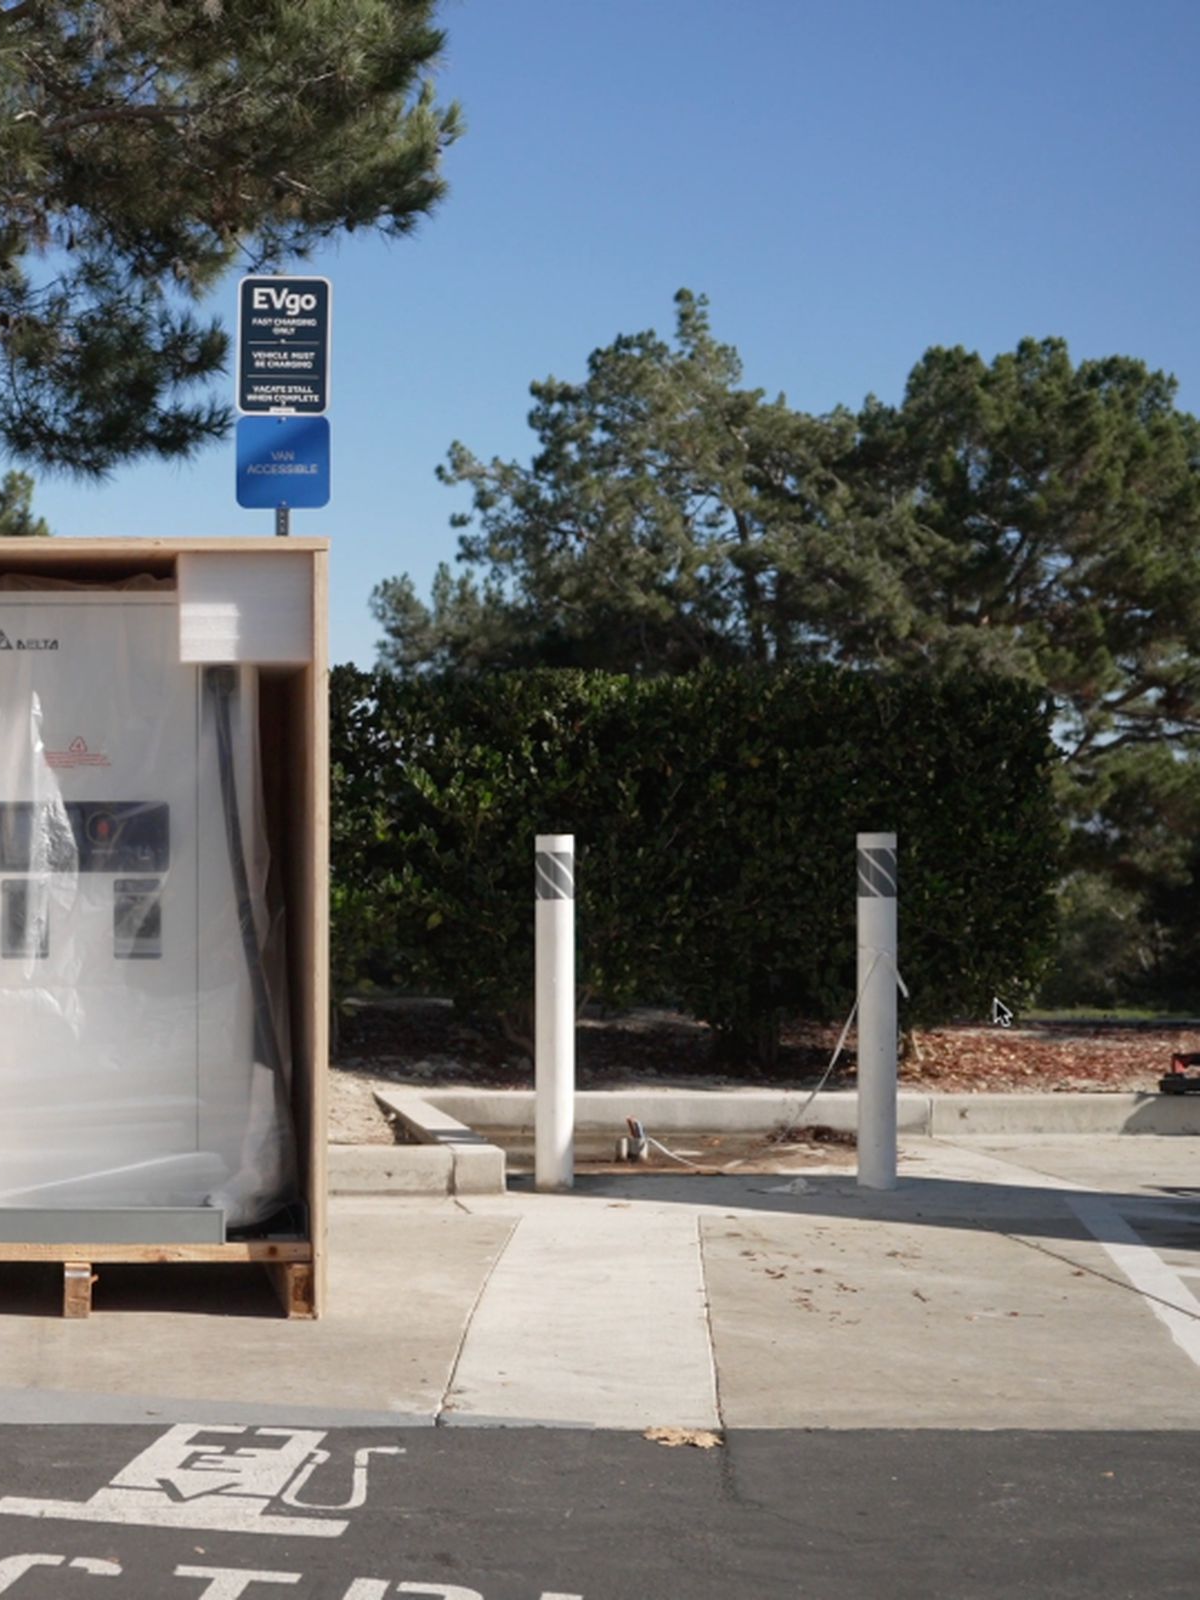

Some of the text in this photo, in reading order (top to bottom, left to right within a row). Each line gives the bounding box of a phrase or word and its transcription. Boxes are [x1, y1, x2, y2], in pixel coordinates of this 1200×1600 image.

[253, 287, 317, 315] EVgo
[251, 318, 317, 326] FAST CHARGING
[272, 327, 295, 335] ONLY
[252, 352, 316, 360] VEHICLE MUST
[267, 361, 313, 369] CHARGING
[252, 385, 314, 393] VACATE STALL
[246, 394, 319, 402] WHEN COMPLETE
[271, 450, 296, 460] VAN
[247, 464, 318, 473] ACCESSIBLE
[17, 639, 59, 650] DELTA
